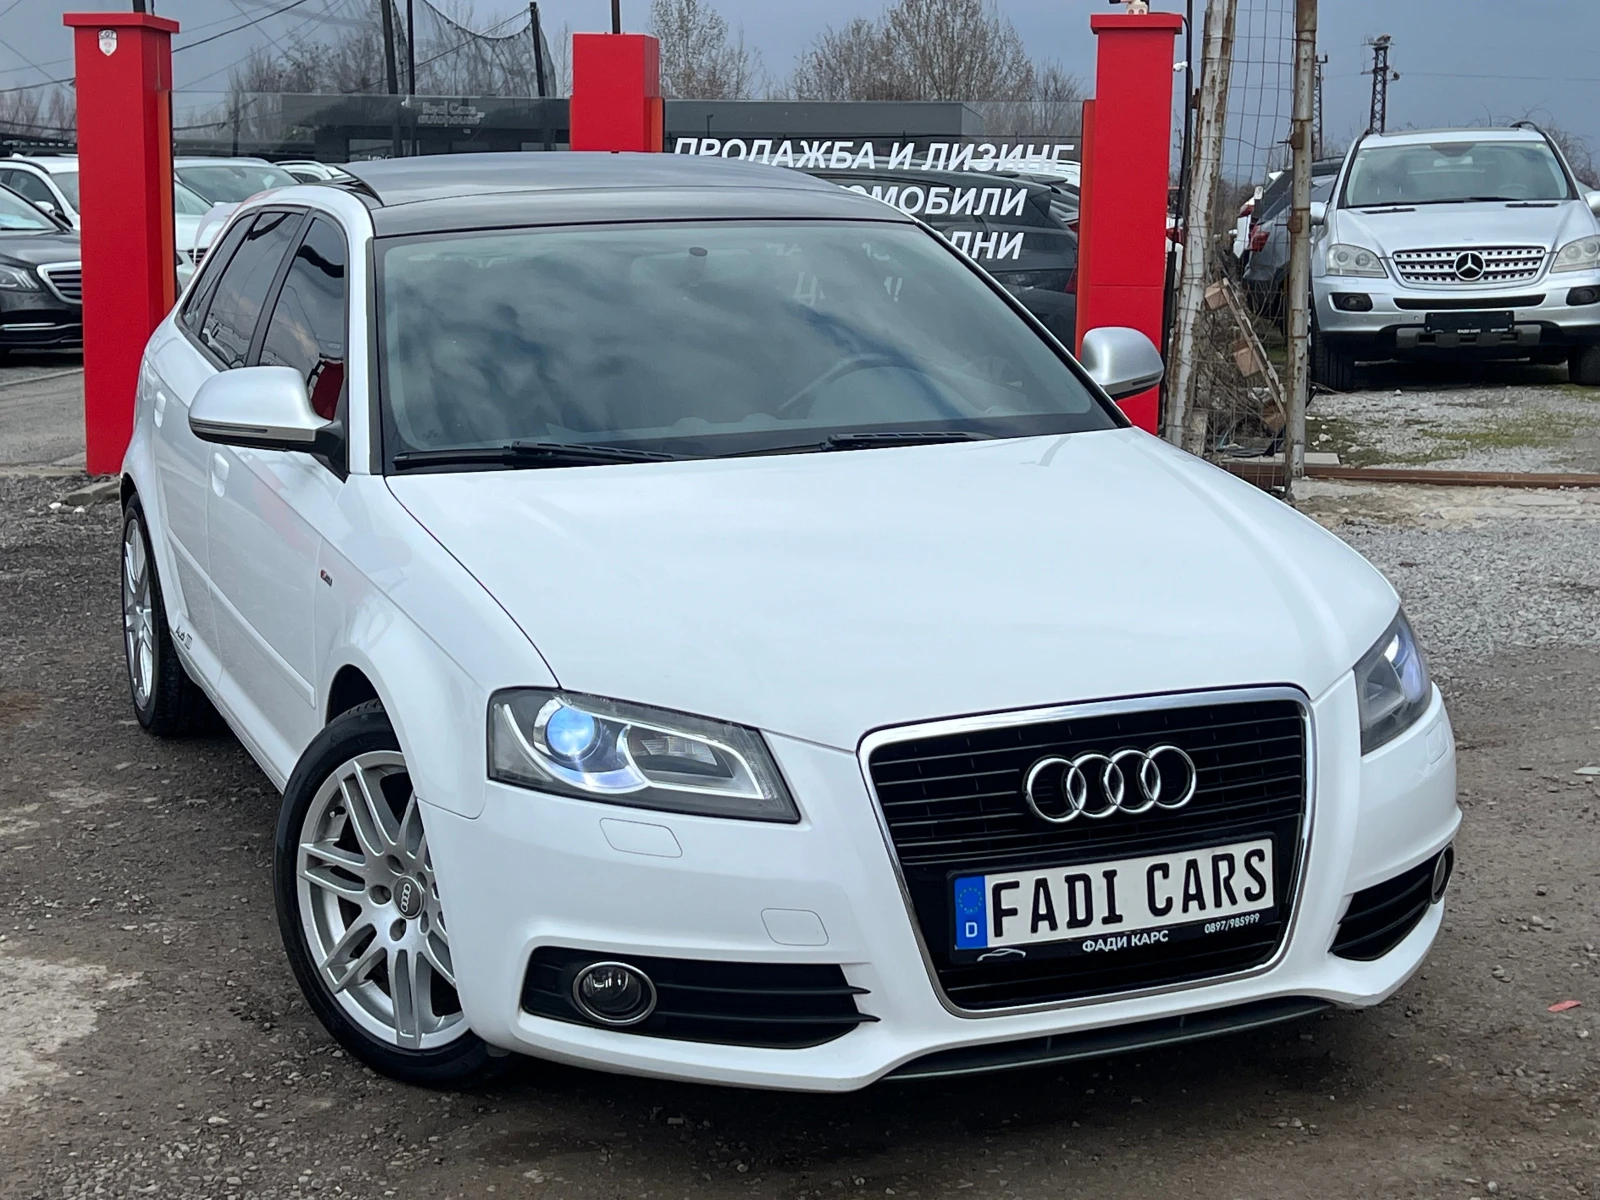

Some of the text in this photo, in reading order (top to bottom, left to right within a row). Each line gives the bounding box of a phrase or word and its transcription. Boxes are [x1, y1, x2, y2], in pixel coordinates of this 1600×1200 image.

[674, 137, 1074, 173] ПРОДАЖБА И ЛИЗИНГ
[992, 849, 1267, 938] FADI CARS
[965, 922, 978, 938] D
[1204, 913, 1260, 934] 0897/985999
[1082, 930, 1169, 953] ФАДИ КАРС
